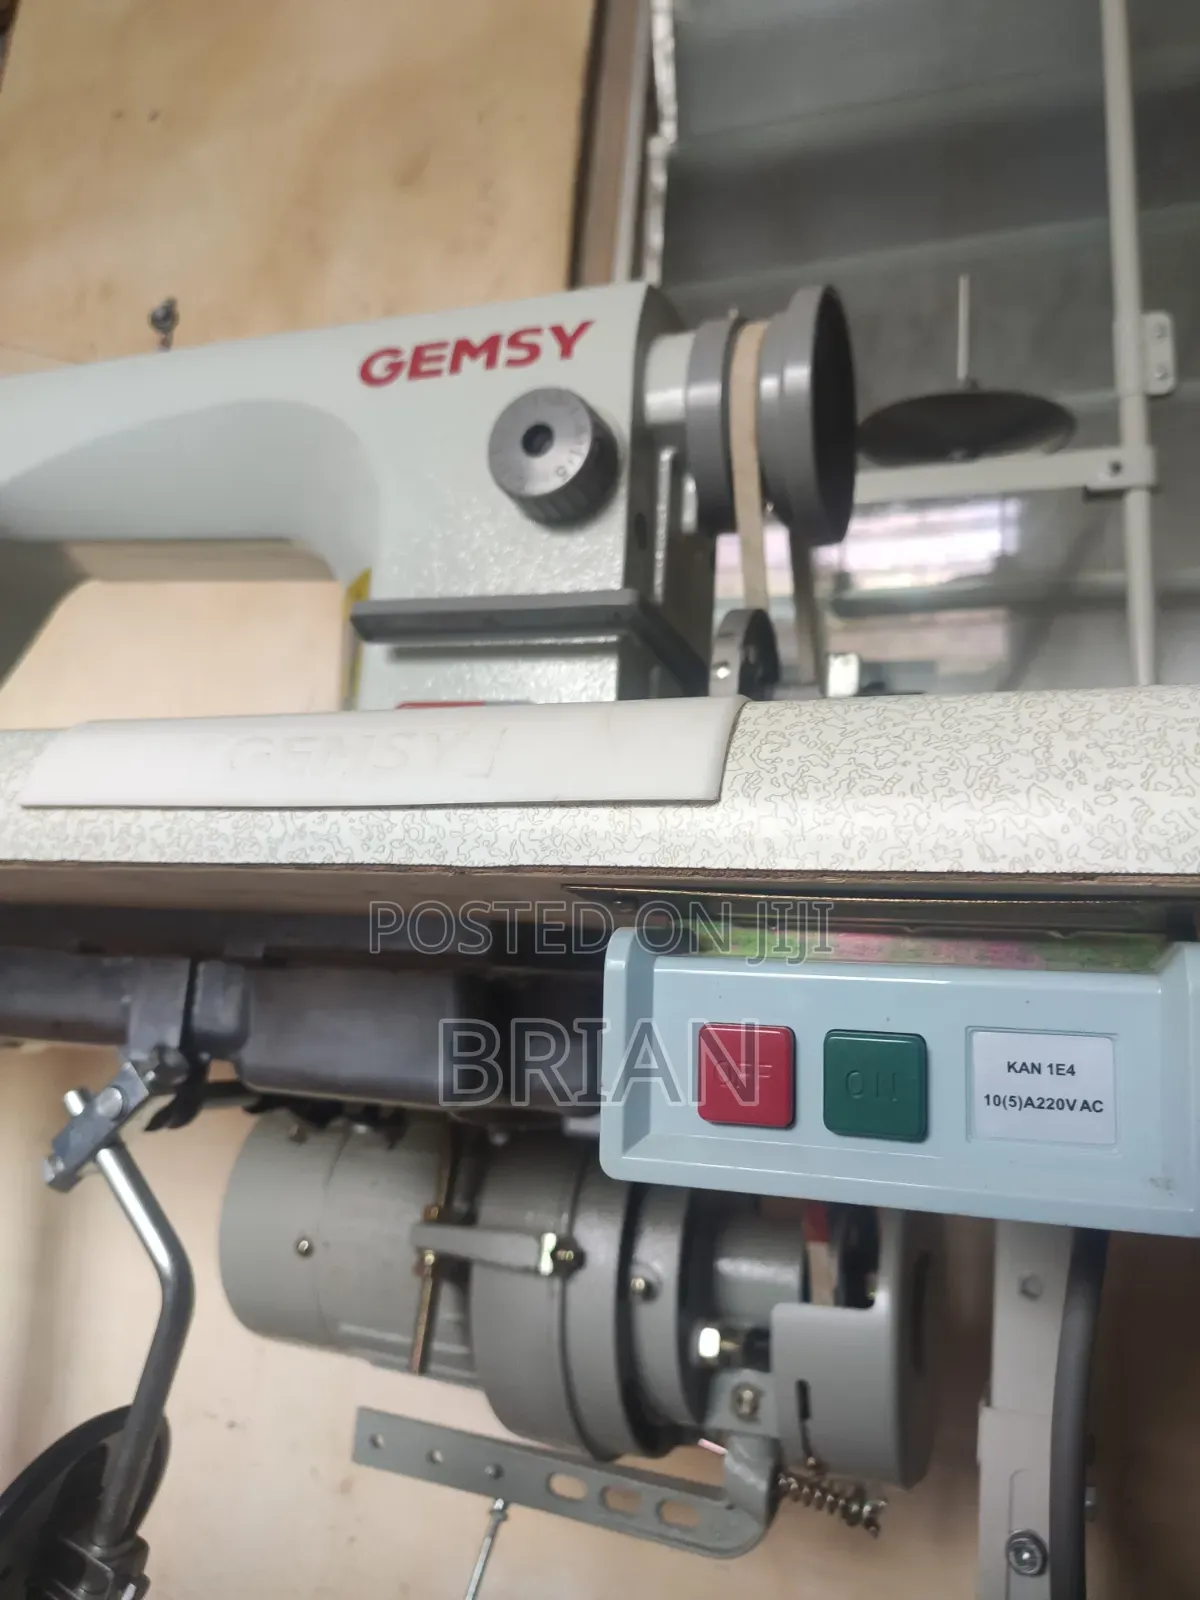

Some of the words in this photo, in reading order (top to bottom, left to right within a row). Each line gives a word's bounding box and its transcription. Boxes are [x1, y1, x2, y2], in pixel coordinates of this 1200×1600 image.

[359, 320, 595, 388] GEMSY
[1006, 1060, 1042, 1075] KAN
[1046, 1062, 1076, 1077] 1E4
